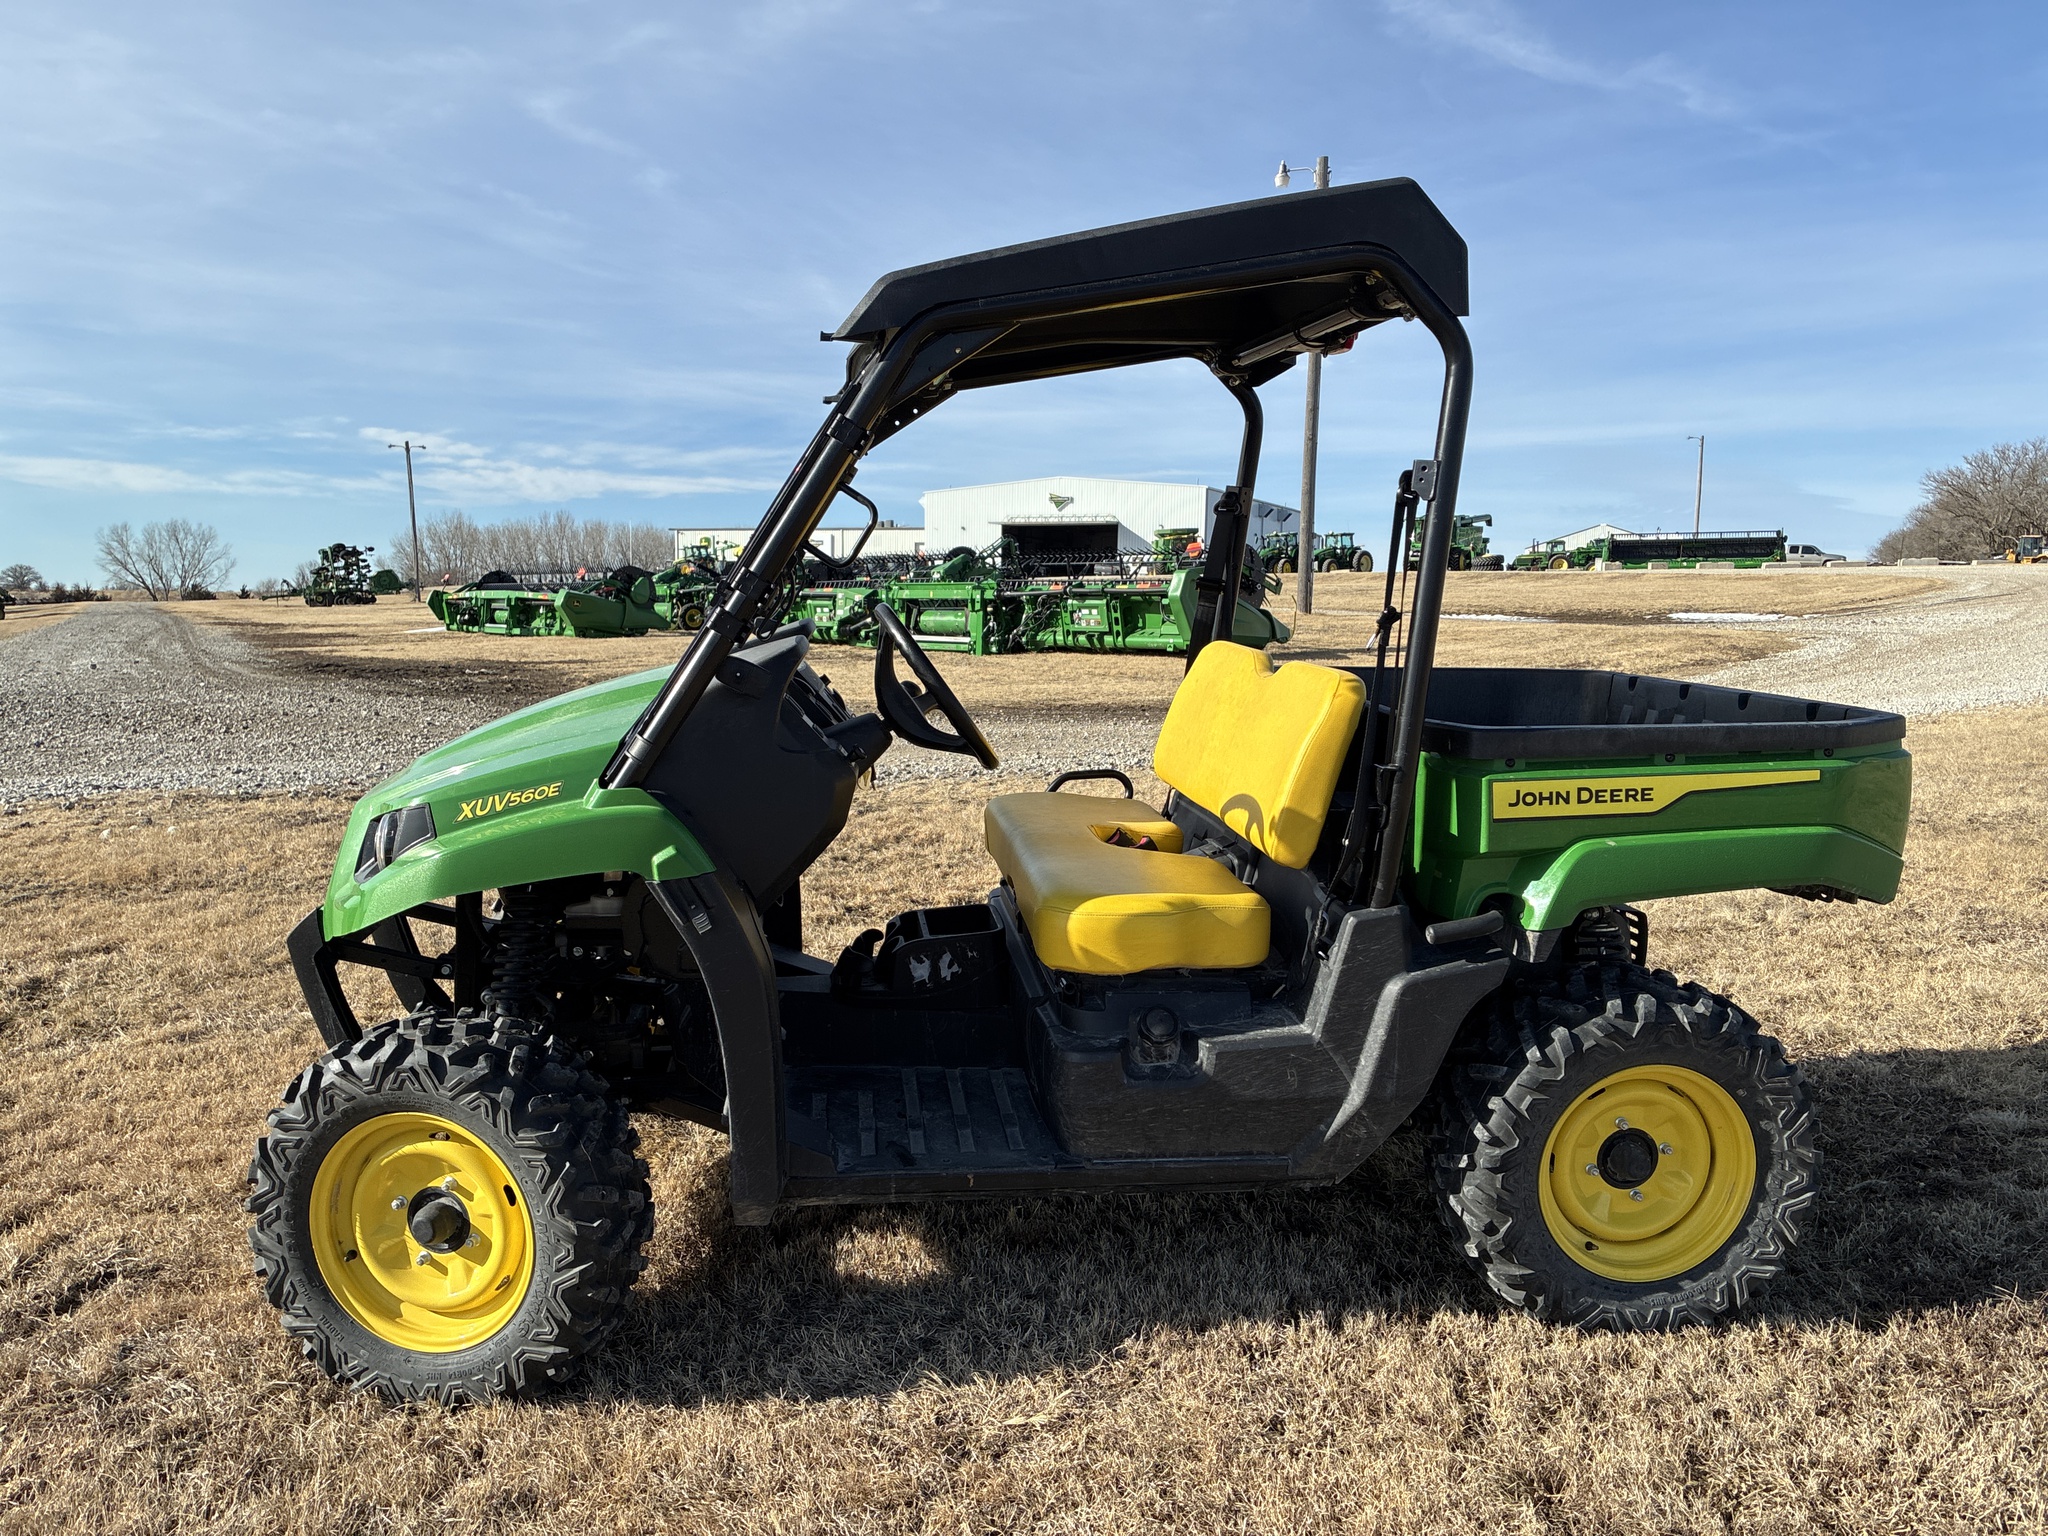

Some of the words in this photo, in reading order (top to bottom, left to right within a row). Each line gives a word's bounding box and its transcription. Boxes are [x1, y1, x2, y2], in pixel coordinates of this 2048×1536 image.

[456, 782, 562, 822] XUV560E
[1508, 789, 1571, 807] JOHN
[1576, 786, 1655, 805] DEERE
[318, 1314, 345, 1343] RADIAL
